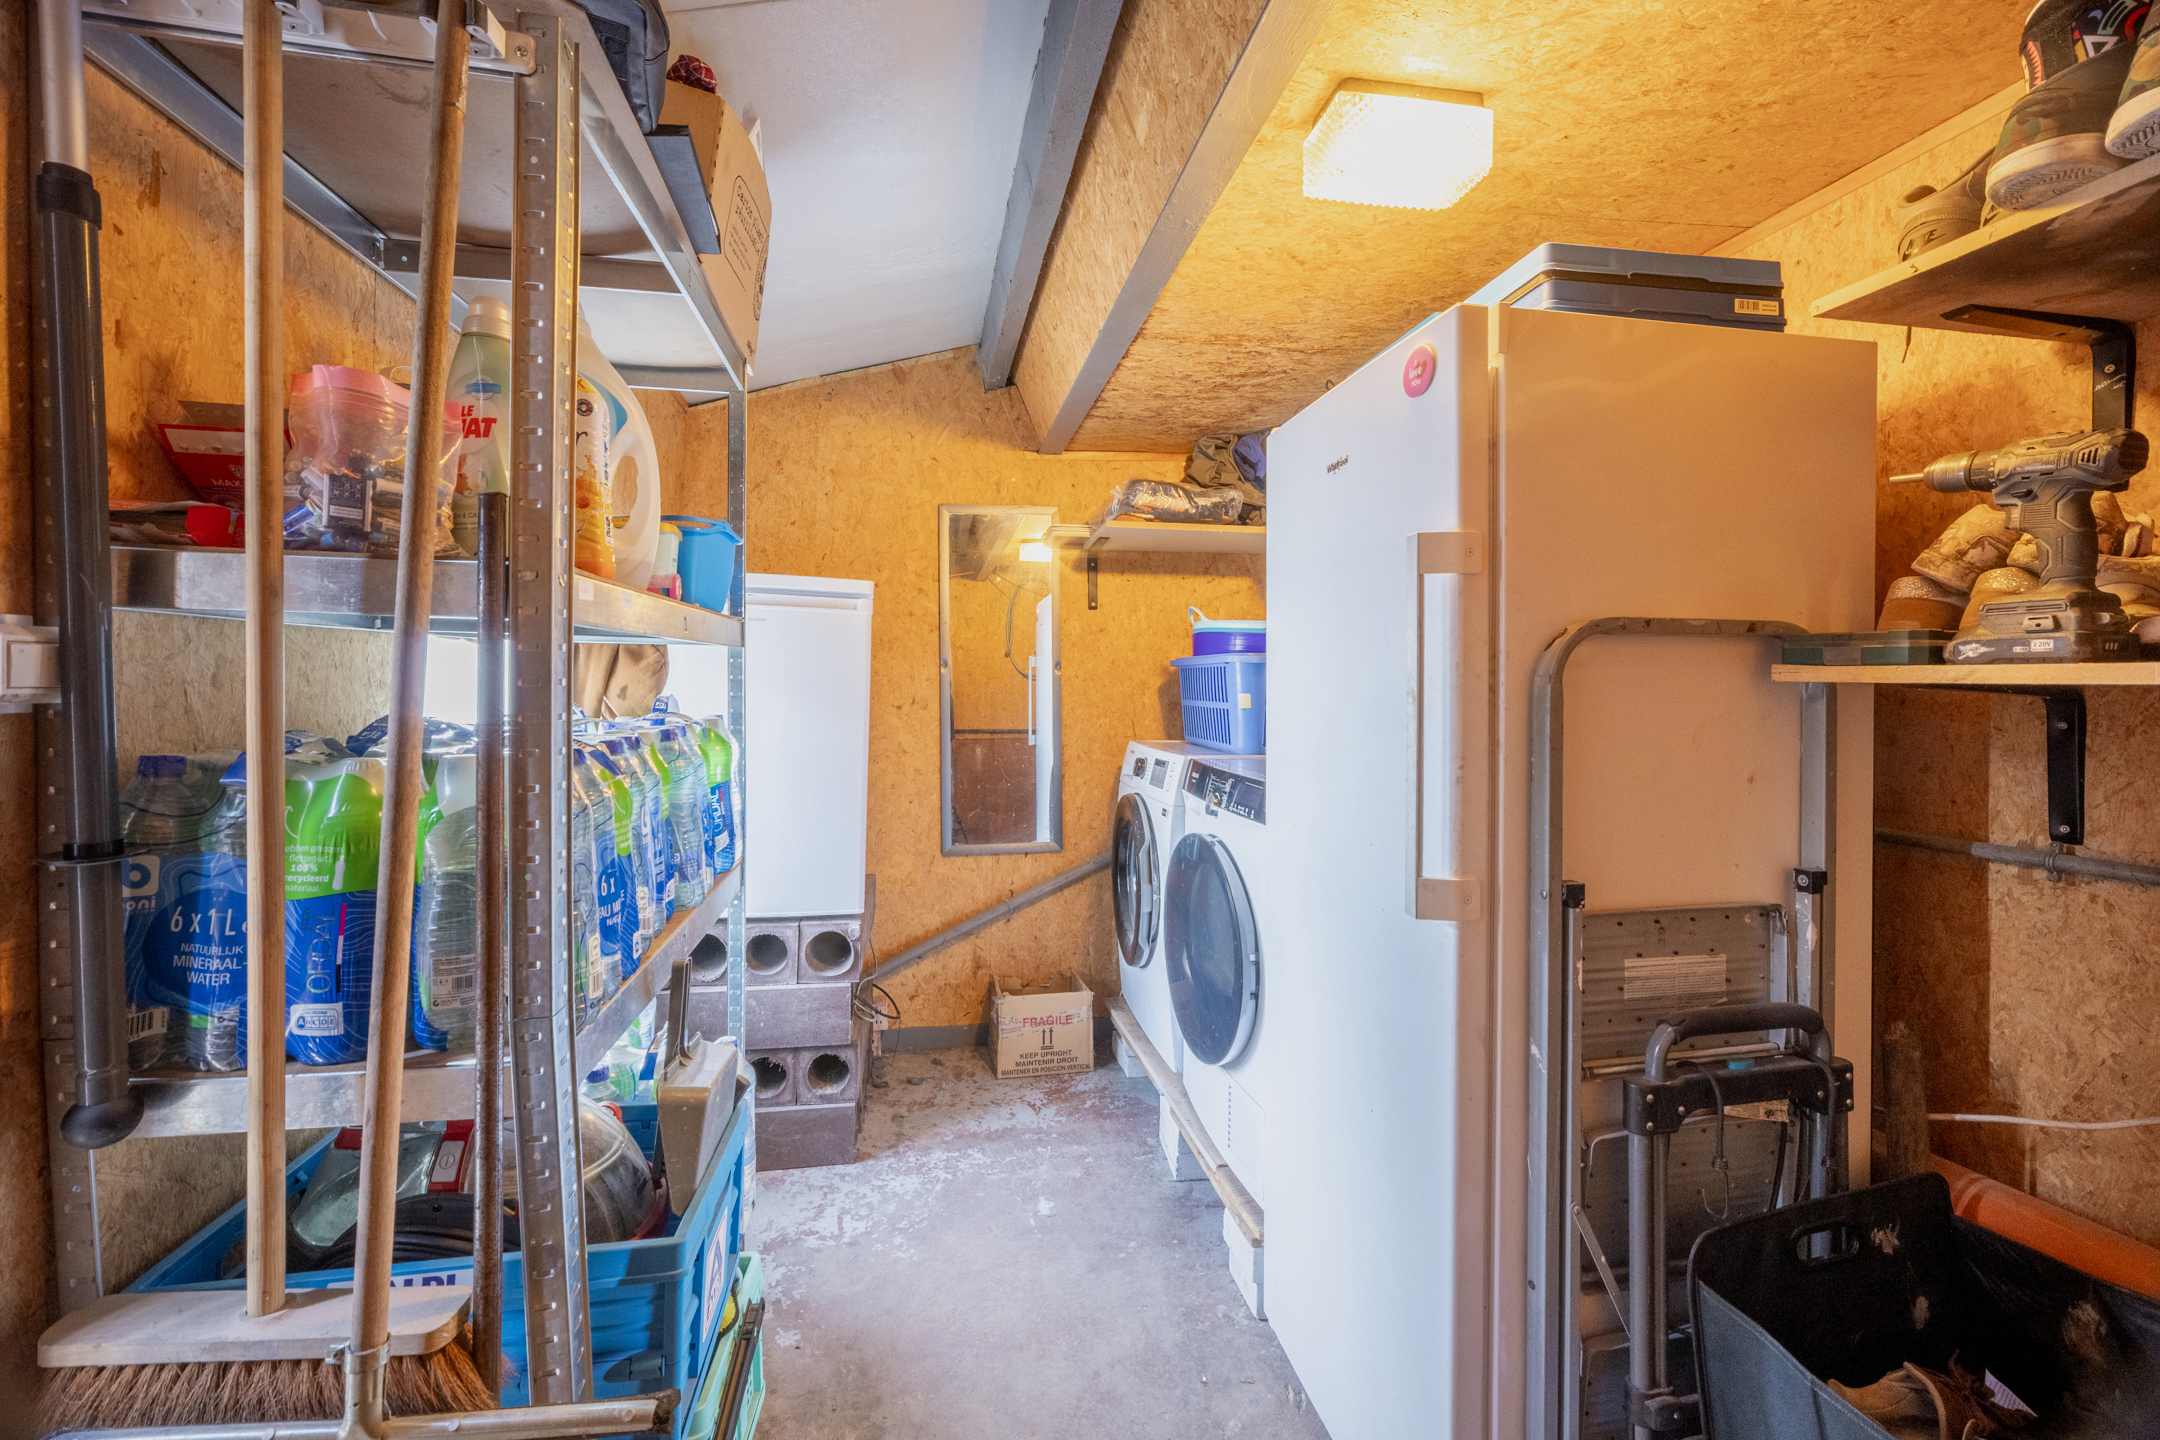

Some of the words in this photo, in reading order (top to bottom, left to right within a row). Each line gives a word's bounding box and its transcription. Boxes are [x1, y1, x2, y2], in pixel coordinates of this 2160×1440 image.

[1411, 378, 1421, 387] YOU
[461, 405, 474, 416] LE
[462, 417, 497, 438] AT
[285, 874, 329, 883] recycleerd
[601, 875, 607, 896] 6
[123, 896, 156, 910] oni
[171, 906, 183, 932] 6
[189, 913, 201, 933] x
[181, 943, 244, 956] NATUURLIJK
[306, 906, 335, 994] ORDAL
[186, 971, 230, 985] WATER
[1022, 1014, 1073, 1027] FRAGILE
[1040, 1050, 1072, 1058] UPRIGHT
[1015, 1059, 1054, 1067] MAINTENIR
[1001, 1067, 1030, 1076] MANTENER
